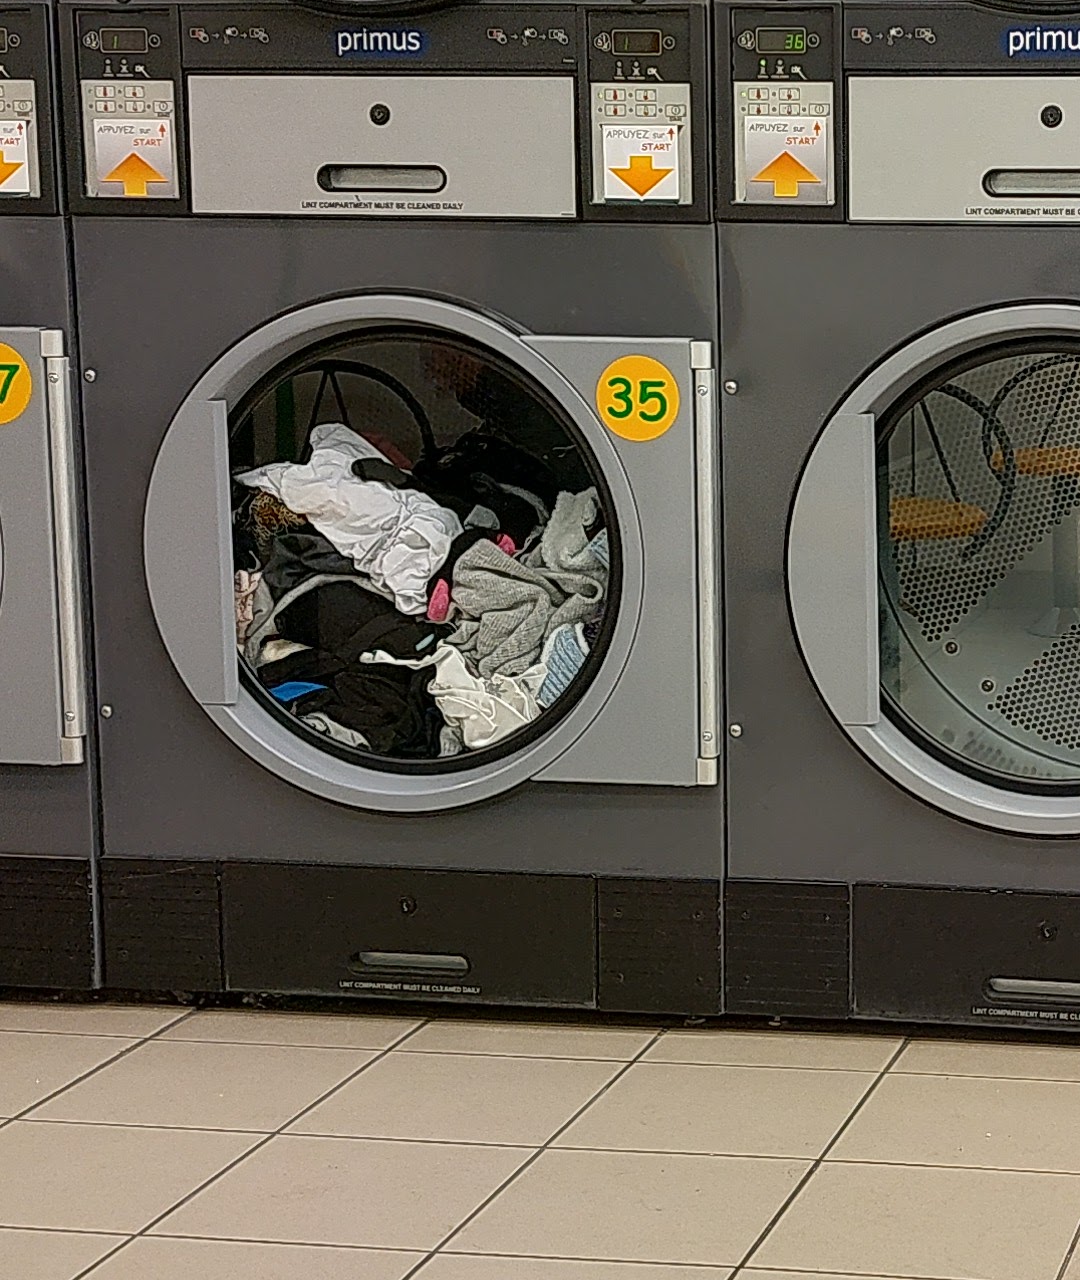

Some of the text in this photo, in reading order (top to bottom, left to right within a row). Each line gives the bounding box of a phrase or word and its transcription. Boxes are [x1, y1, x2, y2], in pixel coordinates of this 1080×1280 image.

[337, 27, 421, 57] primus
[785, 34, 804, 49] 36
[748, 123, 788, 133] APPUYEZ
[605, 129, 650, 139] APPUYEZ
[0, 137, 21, 146] TART
[133, 138, 162, 147] START
[785, 137, 817, 145] START
[641, 142, 672, 151] START
[301, 201, 317, 209] LINT
[319, 201, 373, 210] COMPARTMENT
[374, 202, 395, 210] MUST
[395, 202, 406, 210] BE
[407, 202, 441, 210] CLEANED
[983, 208, 1041, 216] COMPARTMENT
[1042, 207, 1064, 215] MUST
[0, 363, 21, 404] 7
[607, 376, 668, 423] 35
